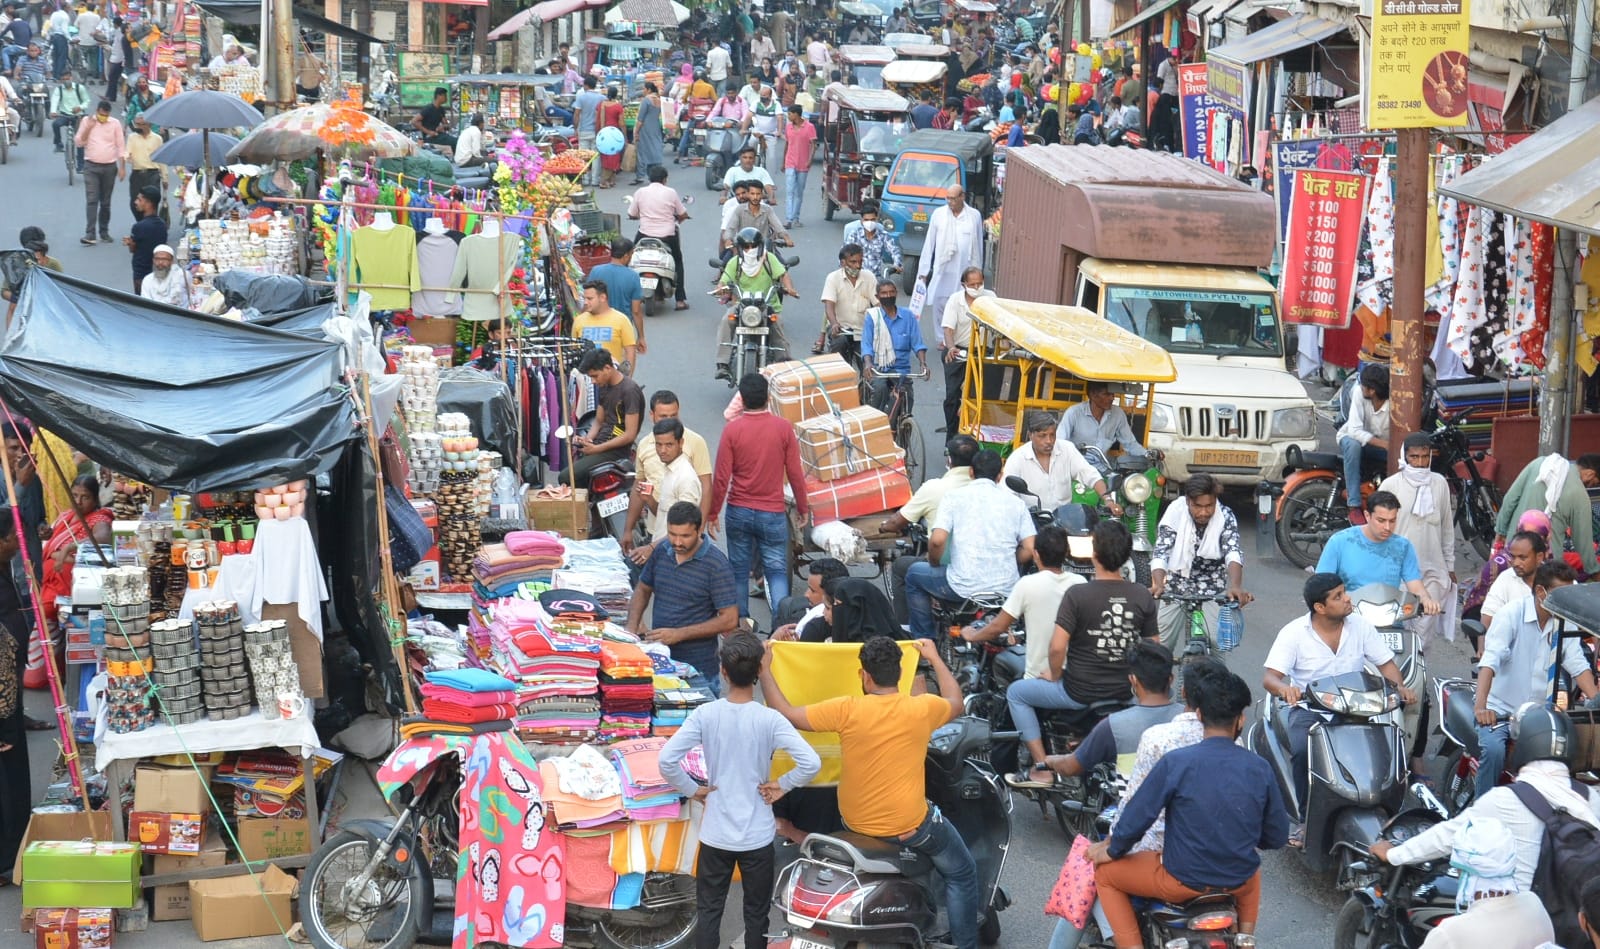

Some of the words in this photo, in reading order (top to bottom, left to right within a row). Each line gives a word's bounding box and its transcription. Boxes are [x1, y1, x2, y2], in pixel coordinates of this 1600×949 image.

[1417, 1, 1439, 14] गोल्ड
[1441, 0, 1458, 13] लोन
[1380, 21, 1398, 33] अपने
[1402, 21, 1416, 33] सोने
[1419, 21, 1427, 32] के
[1380, 35, 1388, 46] के
[1429, 36, 1447, 46] लाख
[1379, 50, 1393, 60] तक
[1396, 50, 1406, 60] का
[1378, 62, 1394, 73] लोन
[1377, 100, 1399, 109] 98382
[1334, 177, 1360, 200] शर्ट
[1318, 199, 1340, 214] 100
[1316, 214, 1338, 229] 150
[1313, 229, 1336, 244] 200
[1311, 245, 1334, 260] 300
[1310, 260, 1333, 275] 500
[1309, 274, 1337, 290] 1000
[1153, 290, 1209, 299] AUTOWHEELS
[1307, 289, 1335, 305] 2000
